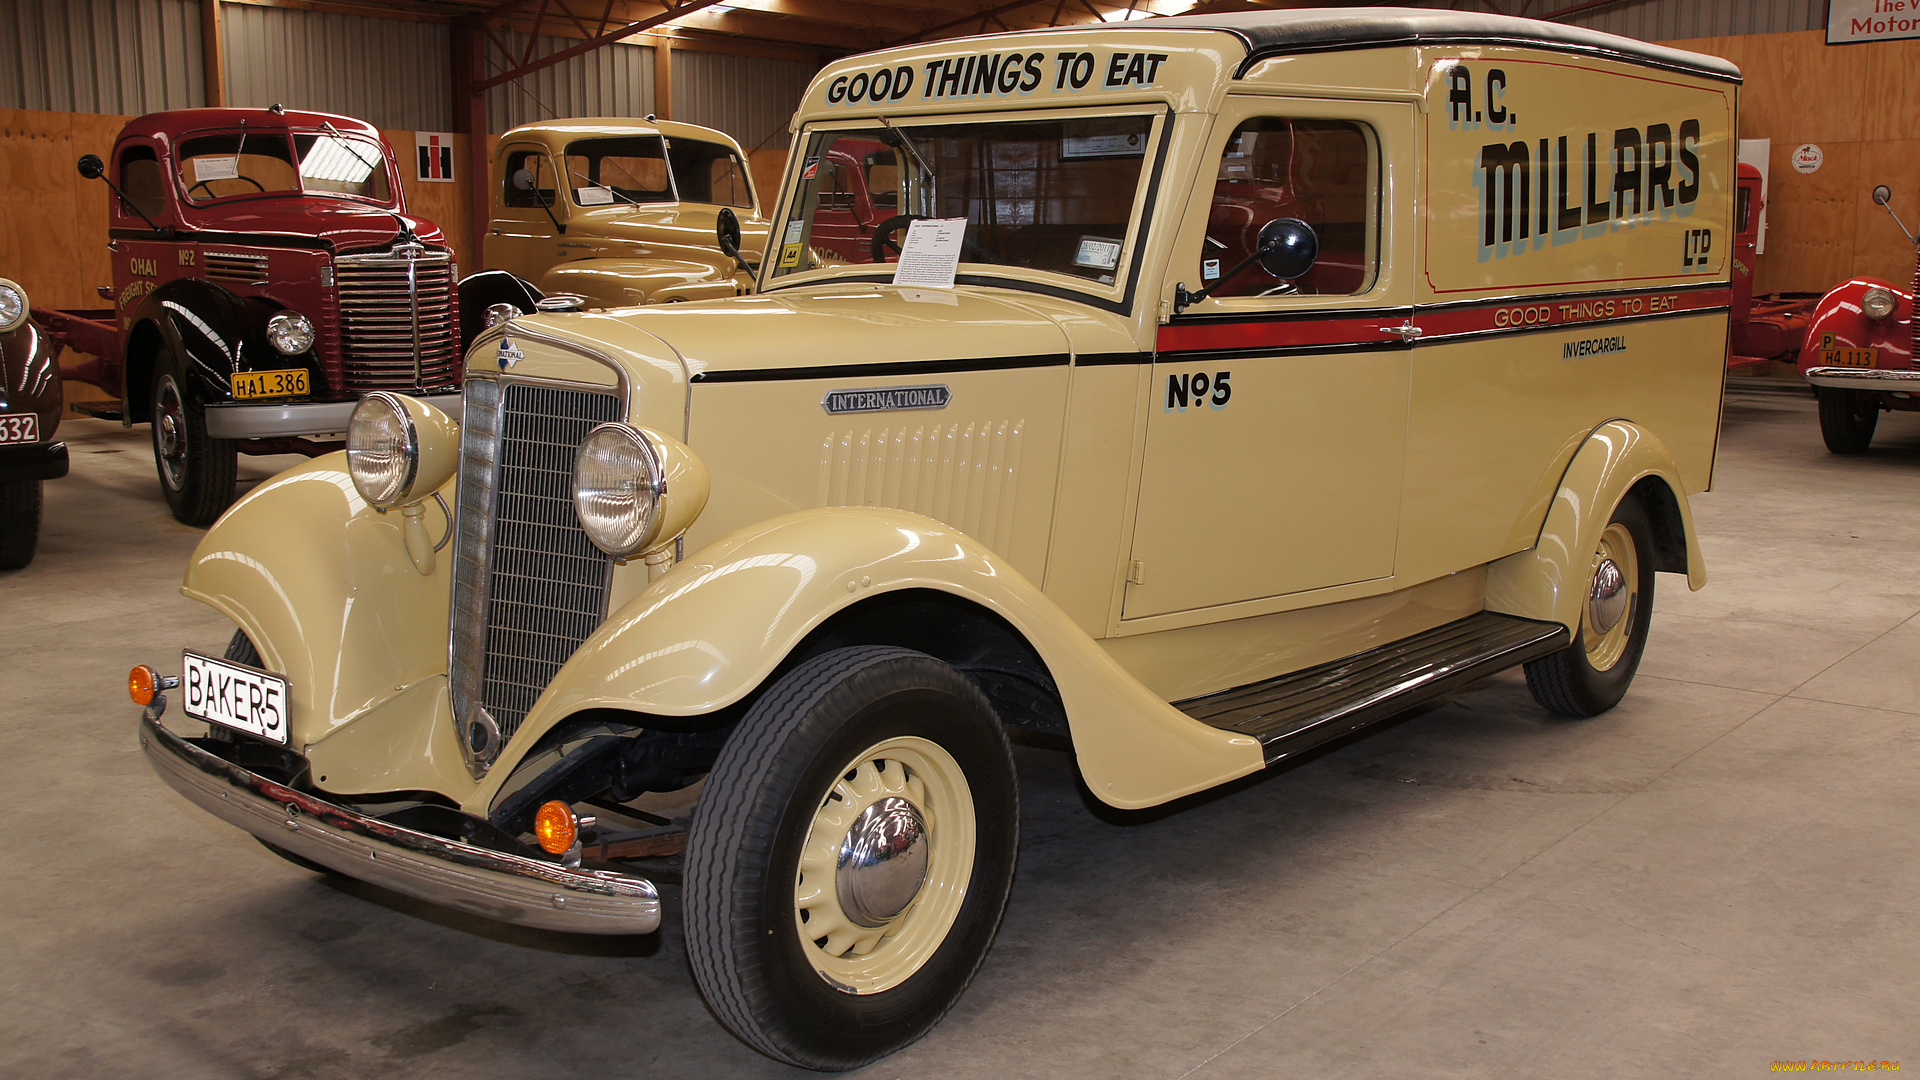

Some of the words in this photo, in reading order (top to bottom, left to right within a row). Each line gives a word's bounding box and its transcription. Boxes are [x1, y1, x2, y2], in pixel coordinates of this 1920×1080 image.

[827, 65, 914, 104] GOOD
[924, 52, 1046, 98] THINGS
[1056, 51, 1095, 90] TO
[1105, 53, 1168, 87] EAT
[1449, 65, 1517, 125] A.C.
[1479, 118, 1701, 248] MILLARS
[786, 250, 797, 259] AA
[1682, 228, 1711, 267] LTD
[130, 257, 158, 277] OHAI
[118, 280, 144, 311] FREIGHT
[1494, 306, 1551, 328] GOOD
[1558, 300, 1616, 321] THINGS
[1621, 298, 1643, 315] TO
[1650, 295, 1678, 312] EAT
[1562, 335, 1627, 359] INVERCARGILL
[1823, 335, 1833, 349] P
[1825, 349, 1872, 367] H4.113
[236, 373, 305, 396] HA1.386
[831, 389, 944, 411] INTERNATIONAL
